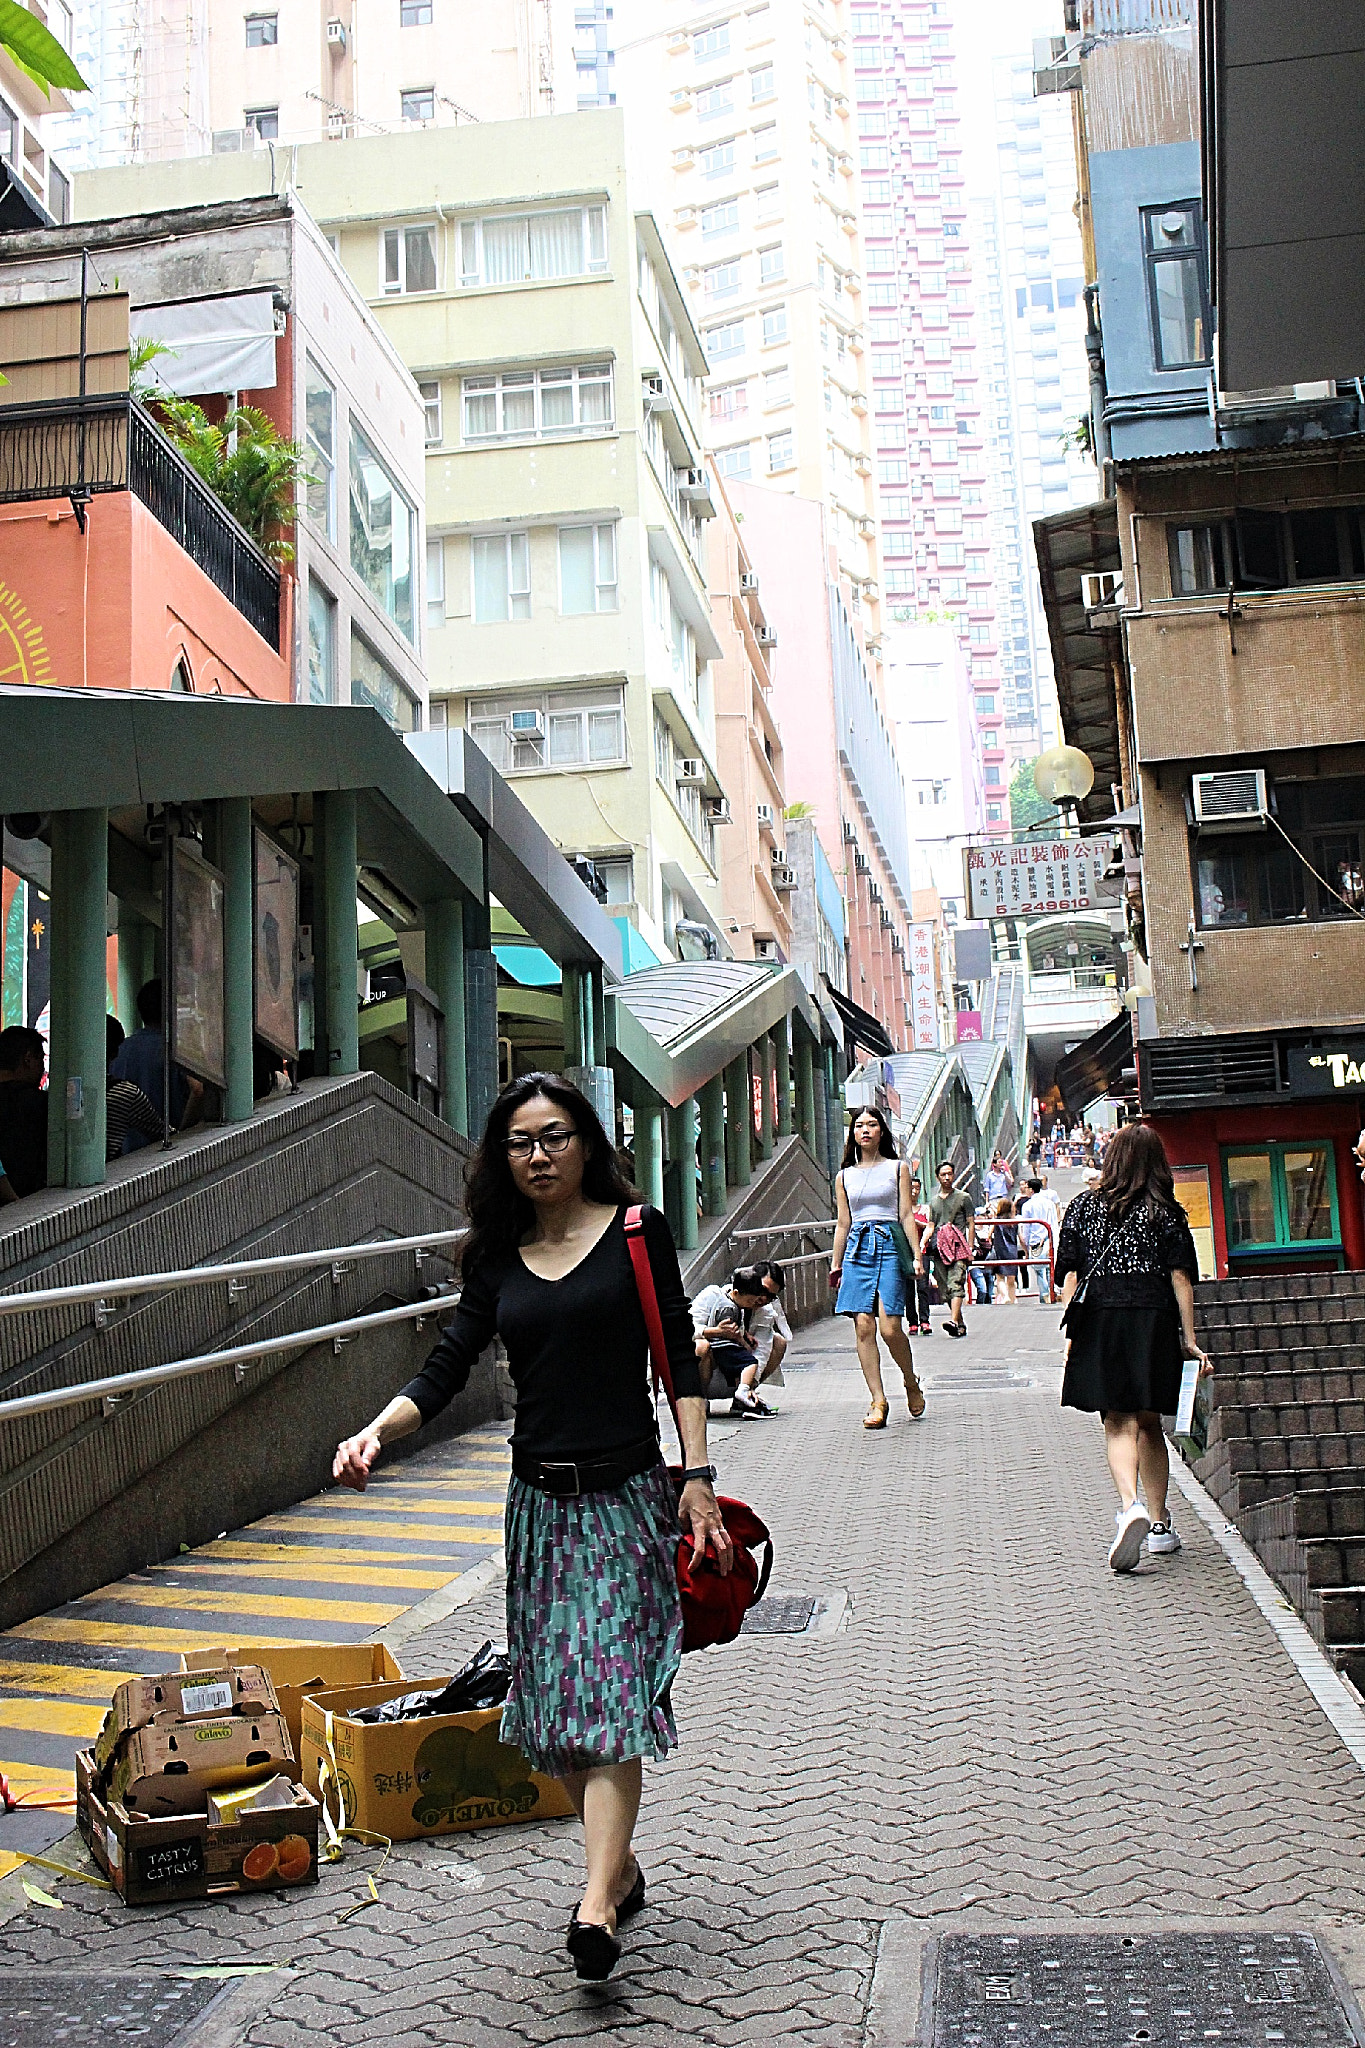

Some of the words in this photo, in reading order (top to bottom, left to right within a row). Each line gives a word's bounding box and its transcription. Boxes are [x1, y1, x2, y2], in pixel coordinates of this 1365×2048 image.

[914, 928, 933, 1044] 香港潮人生命堂
[420, 1795, 533, 1828] POMELO
[149, 1845, 192, 1866] TASTY
[147, 1859, 199, 1880] CITRUS
